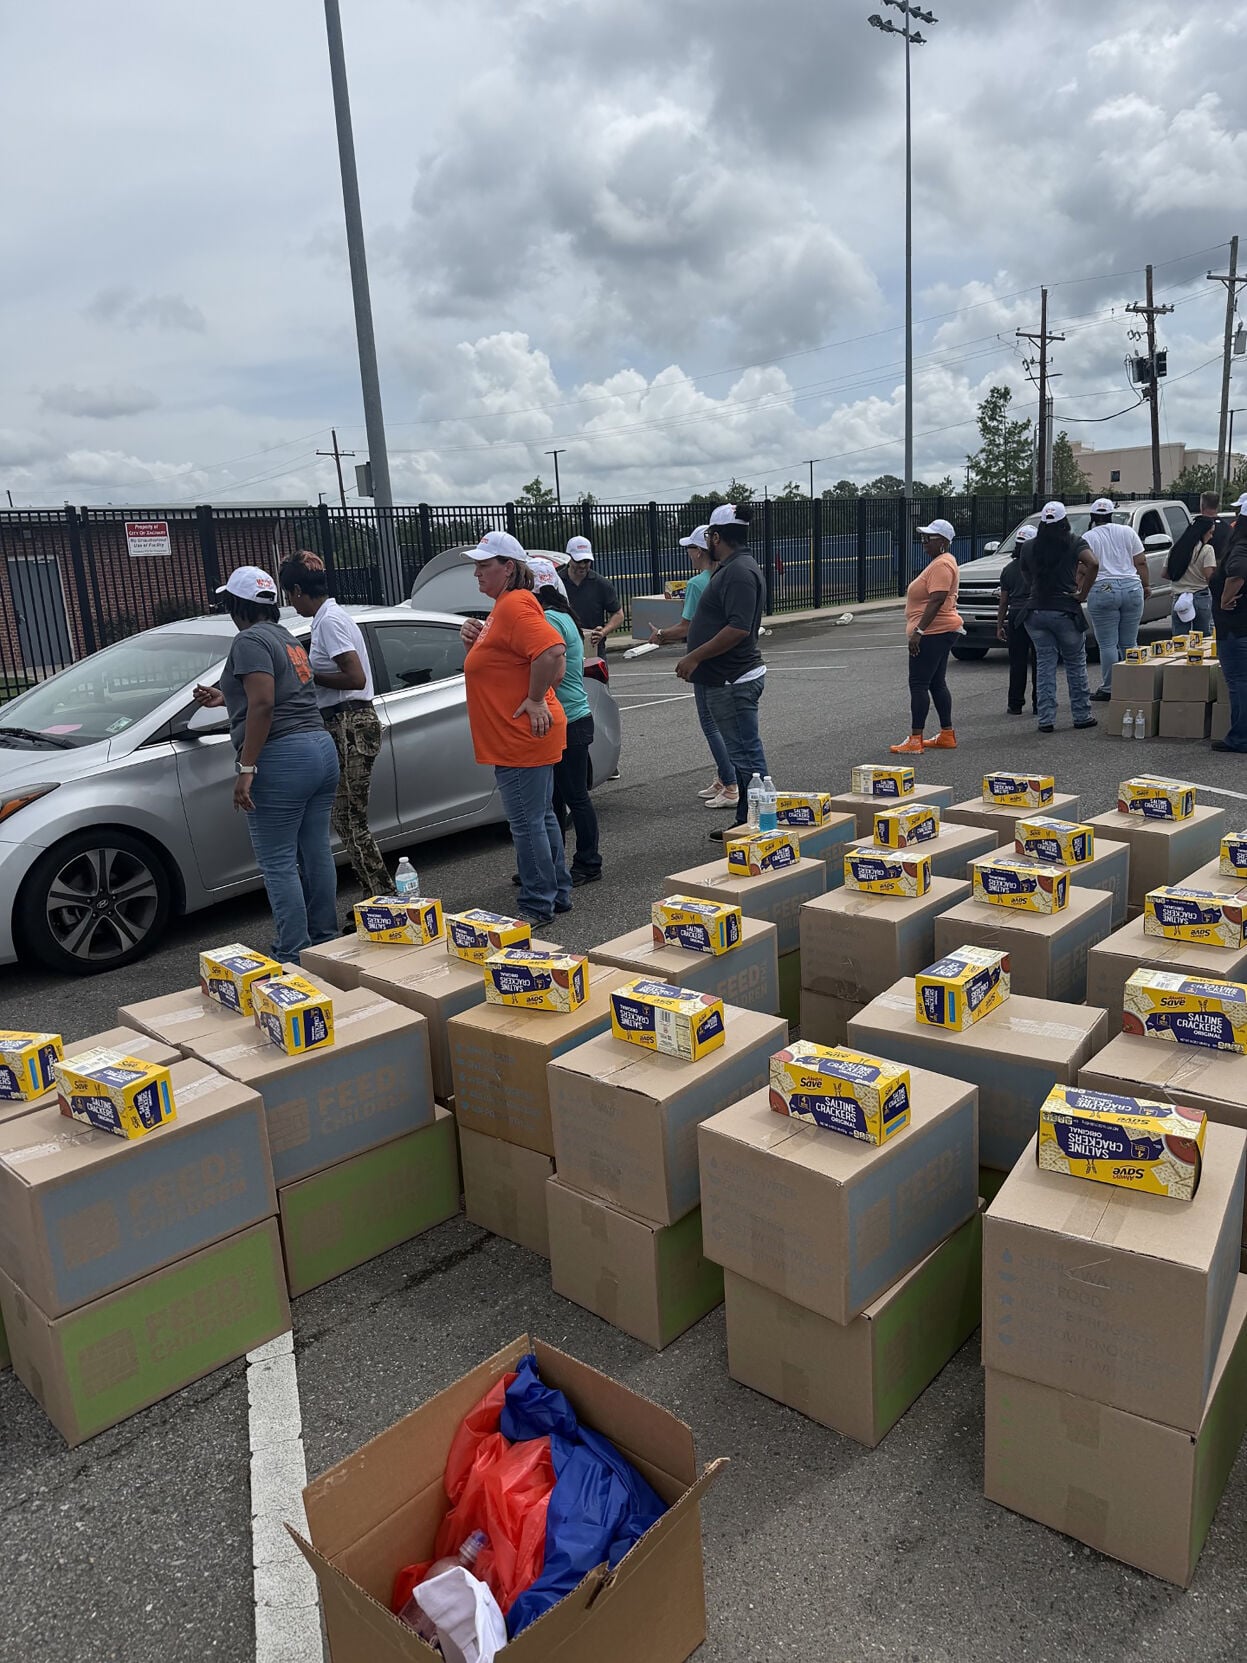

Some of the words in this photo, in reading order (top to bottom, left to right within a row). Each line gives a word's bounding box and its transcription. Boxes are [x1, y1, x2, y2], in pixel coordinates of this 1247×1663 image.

[1163, 909, 1197, 920] CRACKERS
[1163, 916, 1188, 924] SALTINE
[500, 977, 531, 986] CRACKERS
[1160, 998, 1186, 1006] Save
[620, 1010, 649, 1024] CRACKERS
[621, 1018, 643, 1029] SALTINE
[1188, 1013, 1222, 1026] SALTINE
[1177, 1019, 1222, 1033] CRACKERS
[1194, 1030, 1222, 1039] ORIGINAL
[74, 1081, 88, 1090] Save
[800, 1078, 822, 1088] Save
[318, 1066, 396, 1114] FEED
[91, 1097, 112, 1111] SALTINE
[824, 1097, 856, 1113] SALTINE
[1075, 1101, 1116, 1112] SALTINE
[1079, 1097, 1132, 1112] CRACKERS
[87, 1103, 114, 1119] CRACKERS
[816, 1103, 857, 1122] CRACKERS
[831, 1116, 857, 1129] ORIGINAL
[1068, 1126, 1102, 1138] ORIGINAL
[1068, 1133, 1123, 1152] CRACKERS
[1068, 1142, 1109, 1159] SALTINE
[1112, 1167, 1145, 1179] Save
[128, 1154, 226, 1217] FEED
[144, 1274, 241, 1345] FEED
